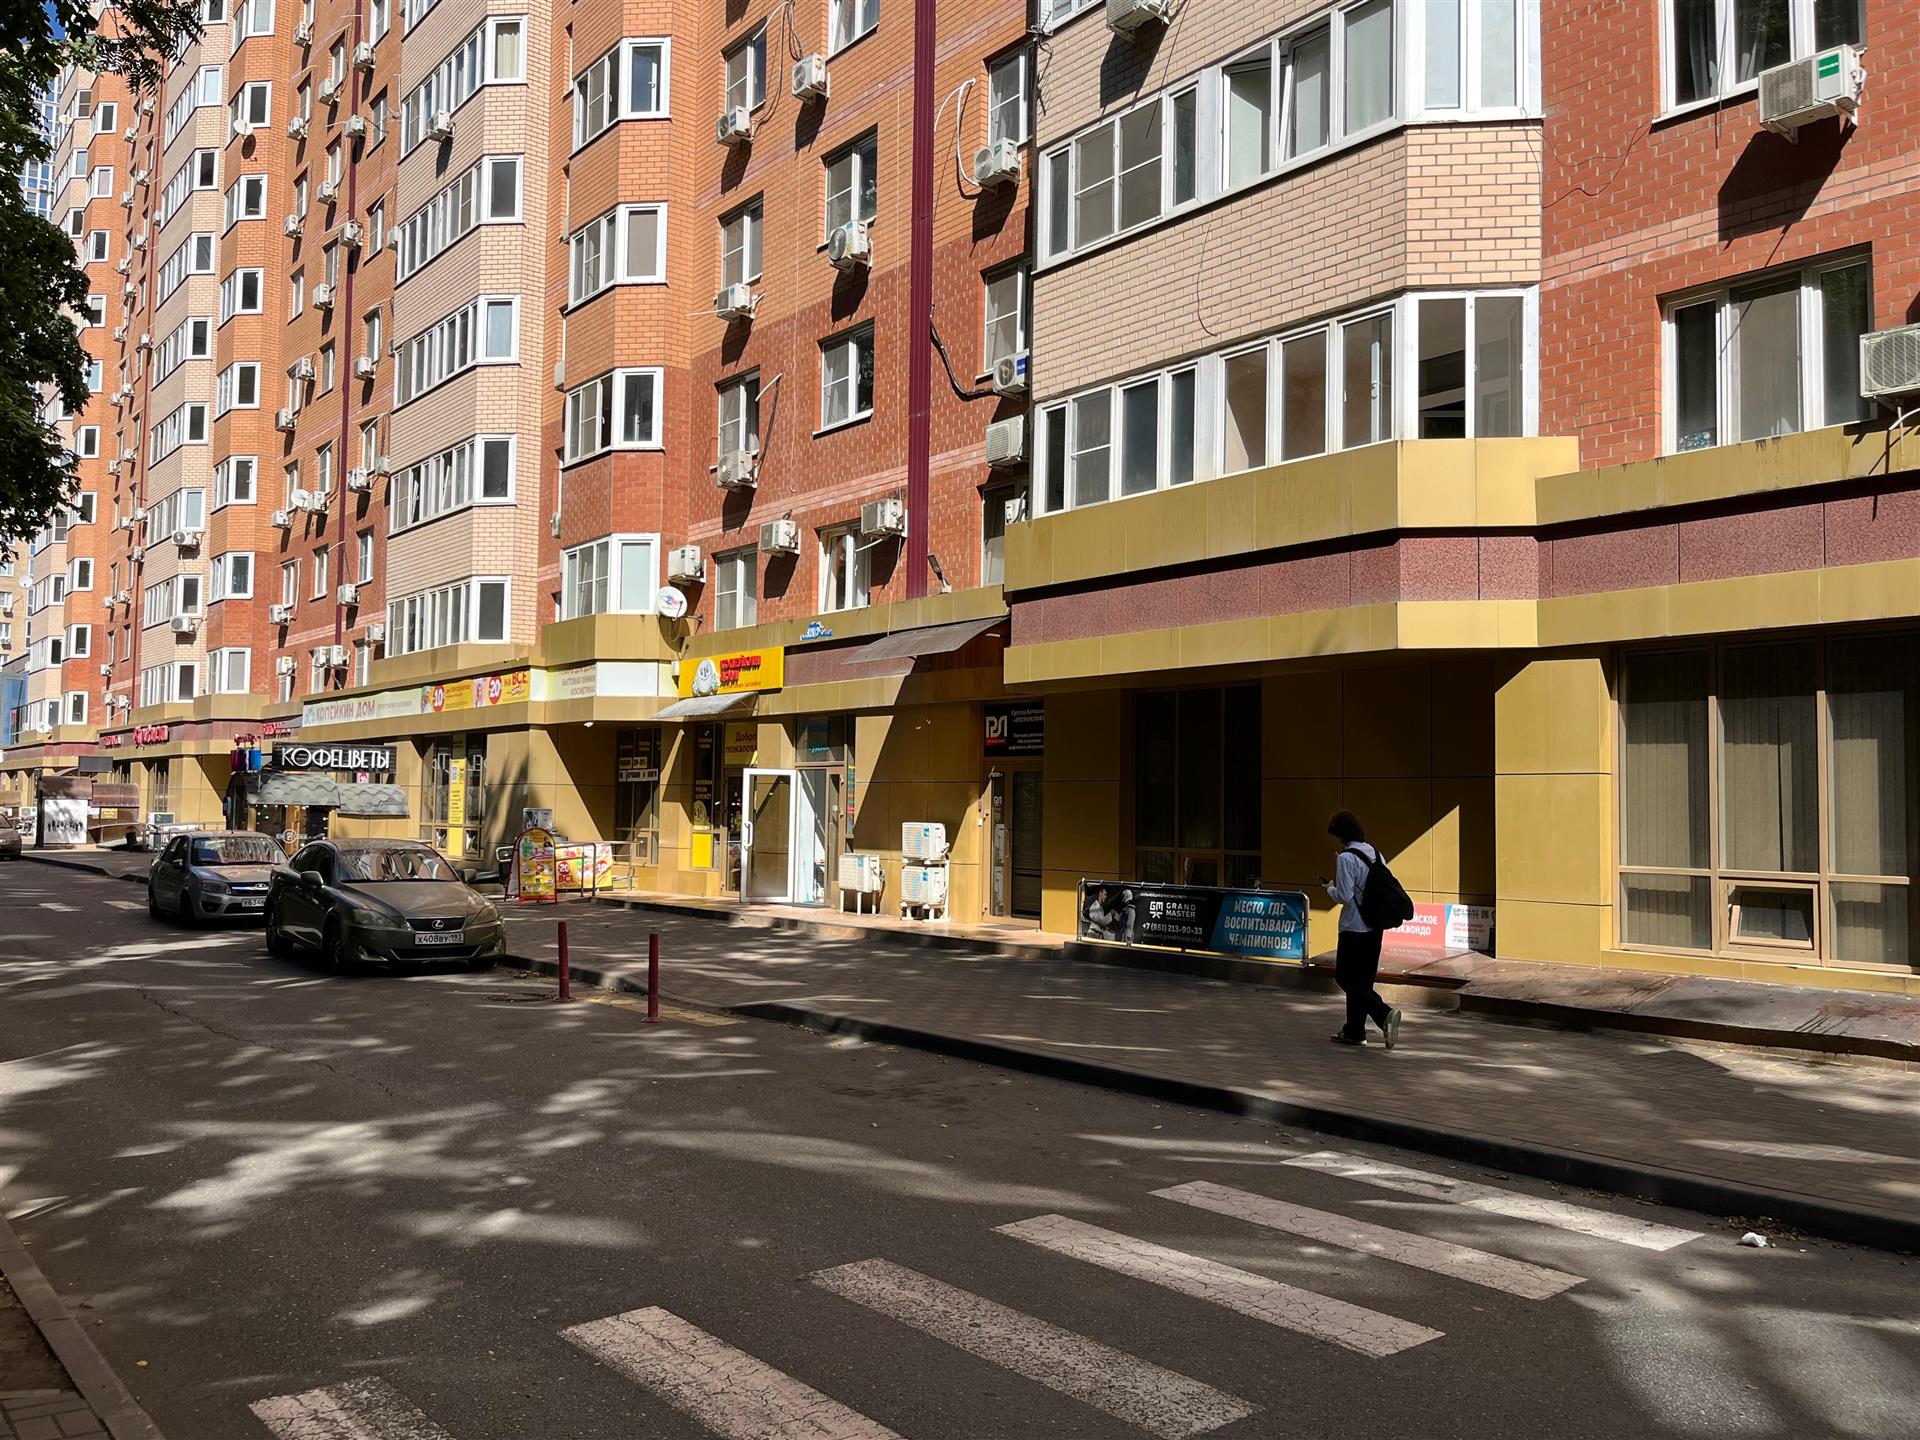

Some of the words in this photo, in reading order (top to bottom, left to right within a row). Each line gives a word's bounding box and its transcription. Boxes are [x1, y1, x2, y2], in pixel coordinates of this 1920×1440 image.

[356, 700, 375, 719] ДОМ
[281, 747, 390, 769] КОФЕЦВЕТЫ
[1165, 902, 1196, 911] GRAND
[1165, 910, 1196, 919] MASTER
[1234, 900, 1266, 915] МЕСТО,
[1267, 901, 1287, 916] ГДЕ
[1168, 925, 1203, 935] 213-90-33
[1224, 916, 1297, 933] ВОСПИТЫВАЮТ
[1229, 933, 1292, 950] ЧЕМПИОНОВ!
